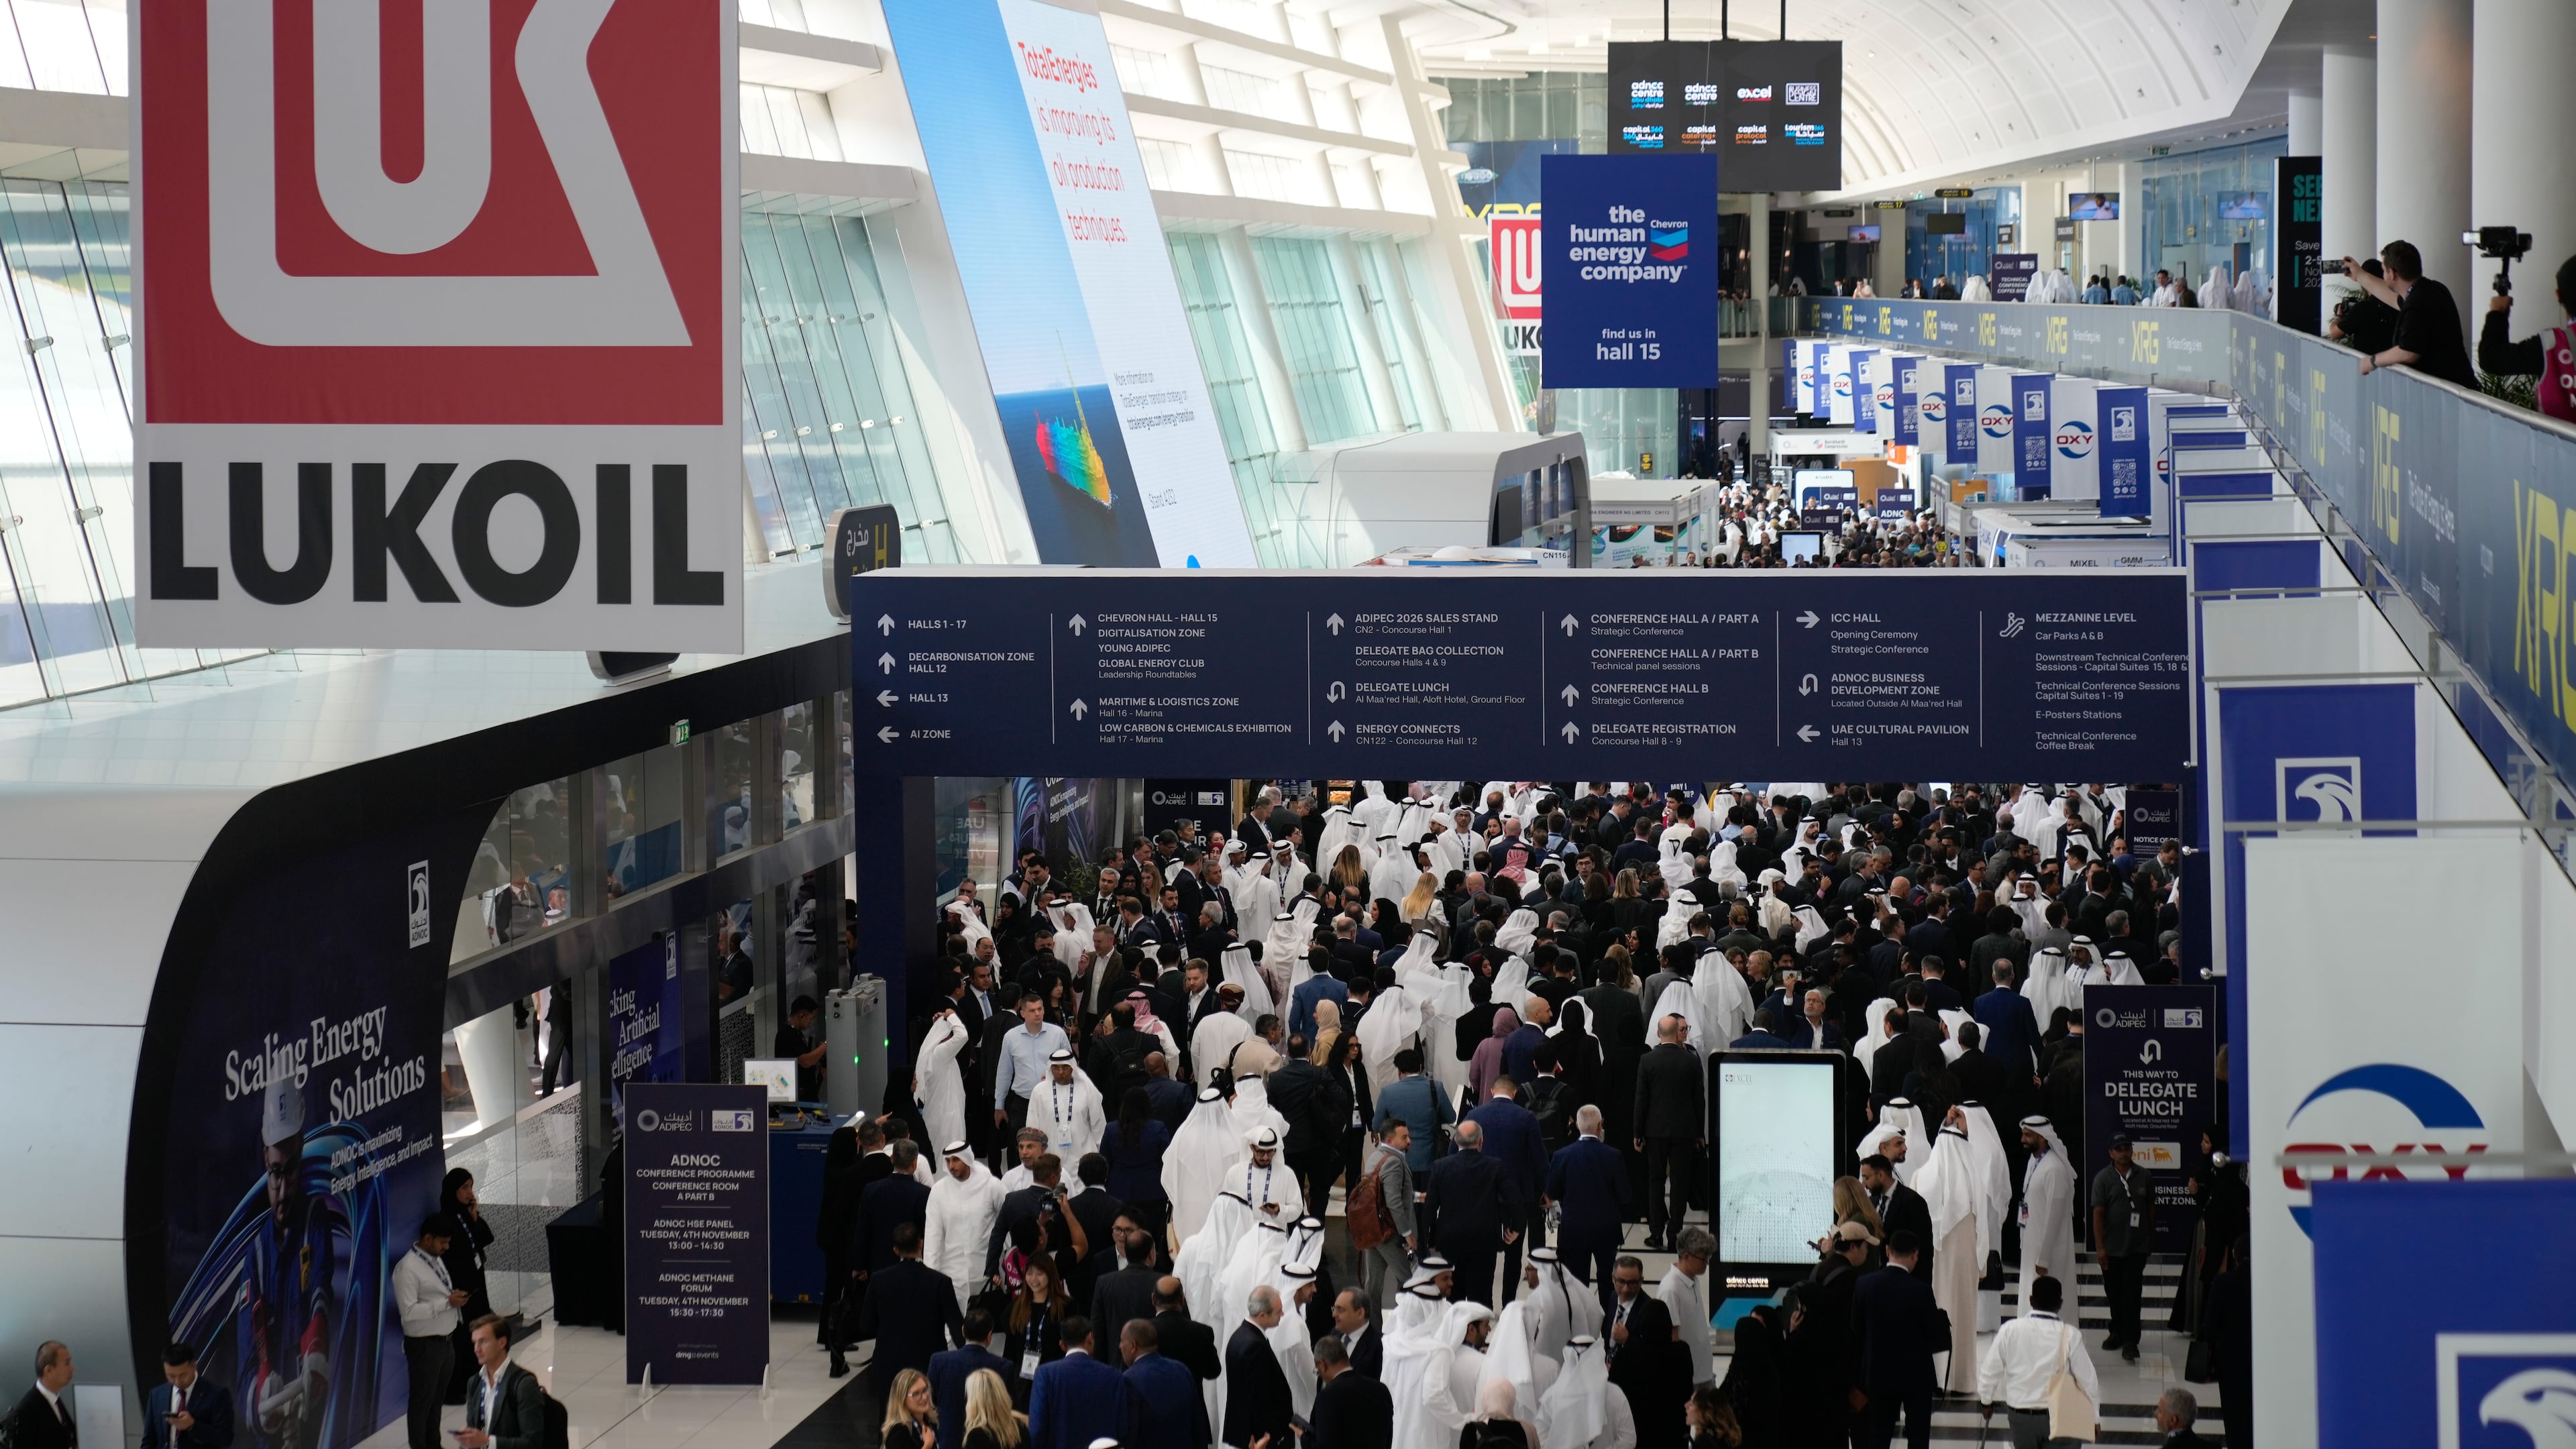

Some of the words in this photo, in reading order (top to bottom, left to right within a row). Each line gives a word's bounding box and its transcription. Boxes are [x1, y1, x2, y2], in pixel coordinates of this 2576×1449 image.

[1018, 42, 1097, 93] TotalEnergies
[1034, 97, 1049, 132] is
[1048, 105, 1102, 145] improving
[1097, 107, 1116, 141] its
[1053, 152, 1069, 186] oil
[1068, 156, 1125, 194] production
[1609, 205, 1645, 223] the
[1066, 207, 1128, 248] techniques.
[1651, 220, 1688, 228] Chevron
[1570, 225, 1645, 242] human
[2296, 241, 2320, 250] Save
[1570, 247, 1646, 264] energy
[1602, 329, 1625, 338] find
[1646, 329, 1655, 338] in
[2132, 321, 2159, 364] XRG
[1597, 343, 1632, 360] hall
[1640, 343, 1660, 360] 15
[1982, 417, 2013, 425] OXY
[2057, 435, 2092, 445] OXY
[2372, 402, 2400, 545] XRG
[149, 460, 724, 607] LUKOIL
[847, 523, 868, 556] مخرج
[875, 523, 887, 568] H
[1356, 614, 1394, 623] ADIPEC
[1397, 614, 1423, 623] 2026
[1426, 614, 1459, 623] SALES
[1462, 614, 1498, 622] STAND
[1831, 614, 1850, 622] ICC
[1854, 614, 1880, 622] HALL
[2036, 613, 2101, 622] MEZZANINE
[2104, 613, 2136, 622] LEVEL
[908, 621, 941, 629] HALLS
[1831, 631, 1869, 641] Opening
[1871, 631, 1918, 640] Ceremony
[1136, 644, 1170, 652] ADIPEC
[1356, 647, 1409, 655] DELEGATE
[1412, 647, 1434, 655] BAG
[1436, 647, 1503, 655] COLLECTION
[909, 653, 1004, 661] DECARBONISATION
[1007, 653, 1034, 661] ZONE
[1636, 662, 1659, 671] panel
[1872, 674, 1925, 682] BUSINESS
[1356, 683, 1409, 692] DELEGATE
[1413, 684, 1449, 692] LUNCH
[1592, 684, 1668, 693] CONFERENCE
[1671, 684, 1699, 692] HALL
[1702, 684, 1709, 692] B
[1832, 686, 1909, 694] DEVELOPMENT
[1911, 686, 1939, 694] ZONE
[1592, 696, 1630, 706] Strategic
[1100, 724, 1122, 732] LOW
[1356, 724, 1398, 733] ENERGY
[1401, 725, 1460, 733] CONNECTS
[1593, 724, 1649, 733] DELEGATE
[1652, 724, 1735, 733] REGISTRATION
[1832, 725, 1854, 733] UAE
[1856, 725, 1915, 733] CULTURAL
[1918, 725, 1968, 734] PAVILION
[923, 730, 950, 738] ZONE
[619, 1002, 660, 1047] Artificial
[225, 1032, 309, 1102] Scaling
[311, 1006, 386, 1068] Energy
[611, 1043, 652, 1080] elligence
[329, 1055, 425, 1126] Solutions
[2106, 1083, 2197, 1097] DELEGATE
[2120, 1101, 2183, 1115] LUNCH
[659, 1123, 692, 1131] ADIPEC
[331, 1148, 358, 1170] ADNOC
[358, 1144, 366, 1158] is
[365, 1124, 402, 1152] maximizing
[331, 1169, 357, 1195] Energy,
[357, 1152, 397, 1183] Intelligence,
[396, 1147, 411, 1165] and
[410, 1132, 433, 1159] Impact
[671, 1155, 720, 1166] ADNOC
[637, 1169, 695, 1177] CONFERENCE
[698, 1170, 754, 1178] PROGRAMME
[653, 1182, 710, 1190] CONFERENCE
[640, 1231, 680, 1239] TUESDAY,
